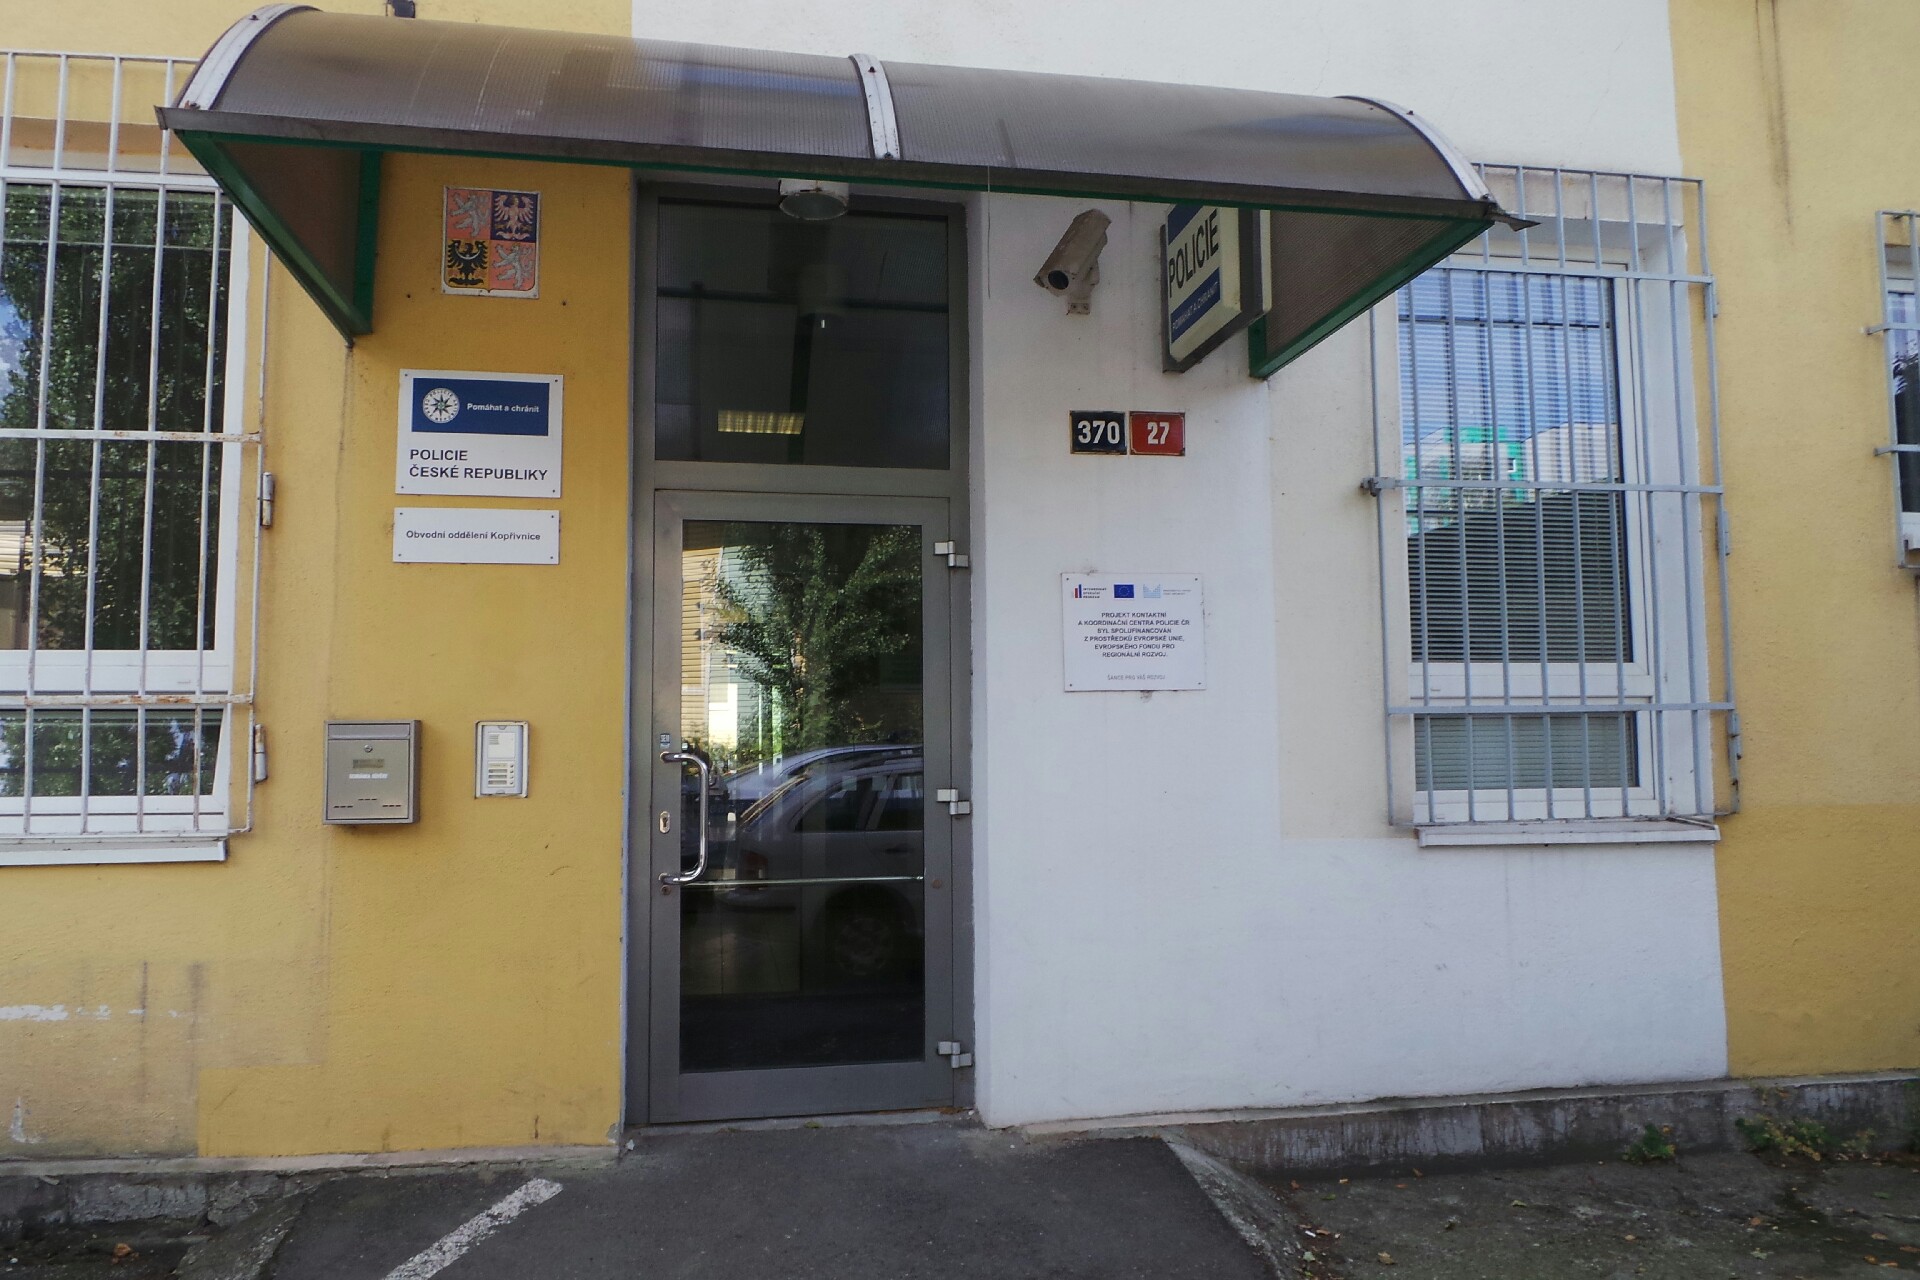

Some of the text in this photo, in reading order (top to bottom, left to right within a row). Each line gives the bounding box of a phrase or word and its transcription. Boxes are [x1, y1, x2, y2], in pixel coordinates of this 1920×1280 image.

[1169, 208, 1219, 298] POLICIE
[467, 402, 503, 411] Pomáhat
[511, 403, 540, 413] chránit
[1077, 420, 1120, 444] 370
[1147, 421, 1170, 445] 27
[410, 449, 468, 461] POLICIE
[409, 464, 548, 480] ČESKÉ REPUBLIKY
[406, 530, 541, 542] Obvodní oddělení Kopřivnice
